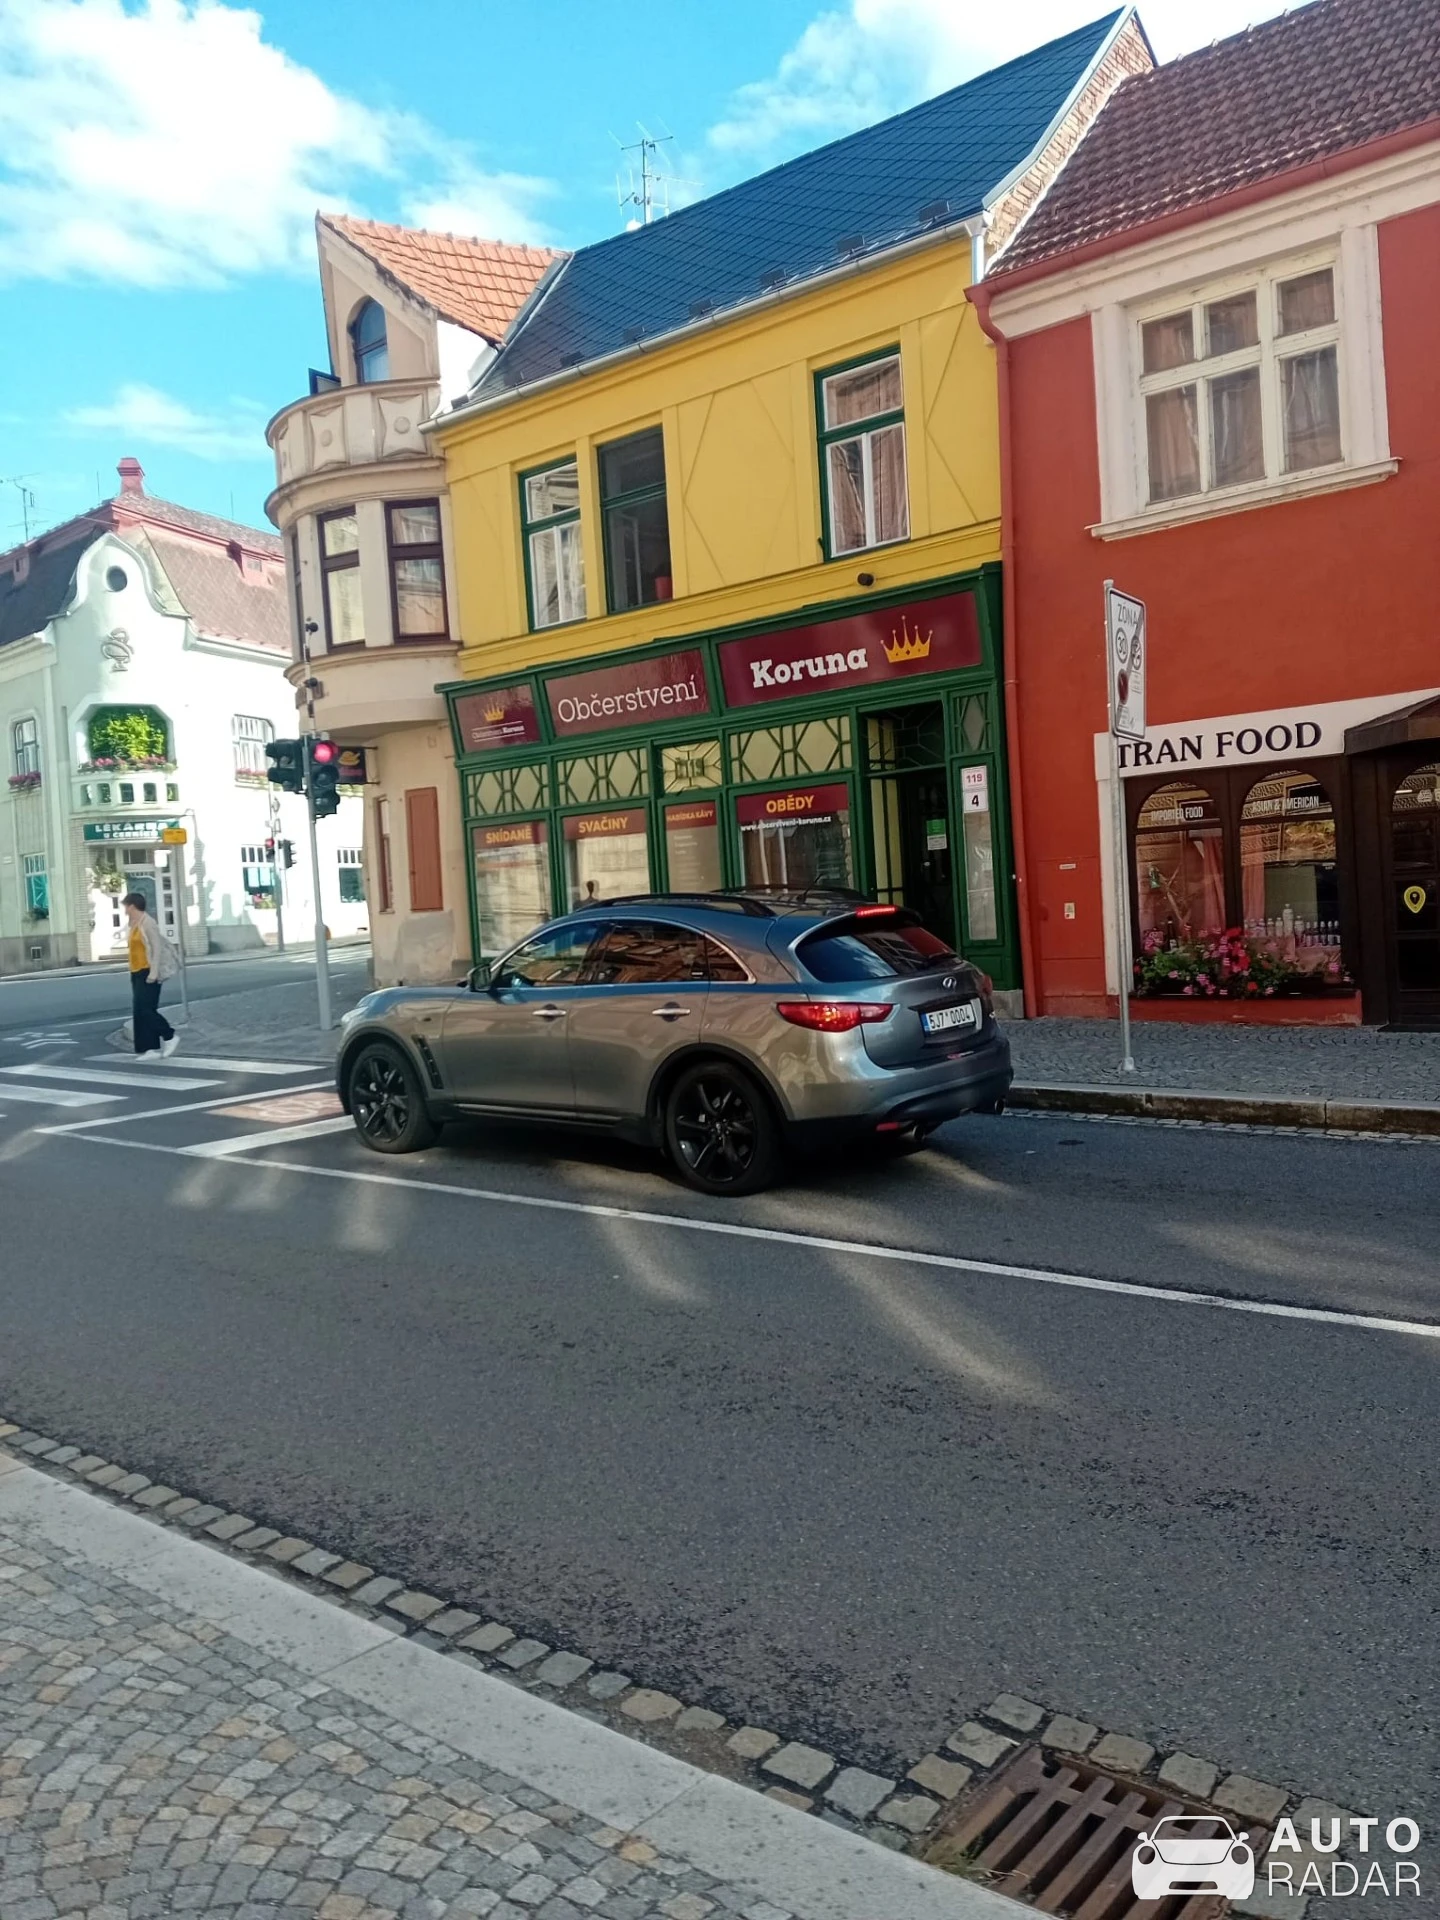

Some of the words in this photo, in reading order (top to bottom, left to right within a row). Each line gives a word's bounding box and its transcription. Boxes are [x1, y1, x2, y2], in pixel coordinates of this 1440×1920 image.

[750, 648, 868, 688] Koruna
[558, 674, 699, 722] Občerstvení
[1118, 735, 1203, 768] TRAN
[1216, 722, 1322, 758] FOOD
[966, 773, 983, 783] 119
[766, 794, 815, 813] OBĚDY
[971, 795, 979, 807] 4
[1252, 799, 1273, 812] ASIAN
[1282, 796, 1319, 810] AMERICAN
[1150, 807, 1184, 821] IMPORTED
[1185, 806, 1203, 819] FOOD
[578, 817, 628, 833] SVAČINY
[485, 825, 533, 844] SNÍDANĚ
[928, 1012, 945, 1029] 5J7
